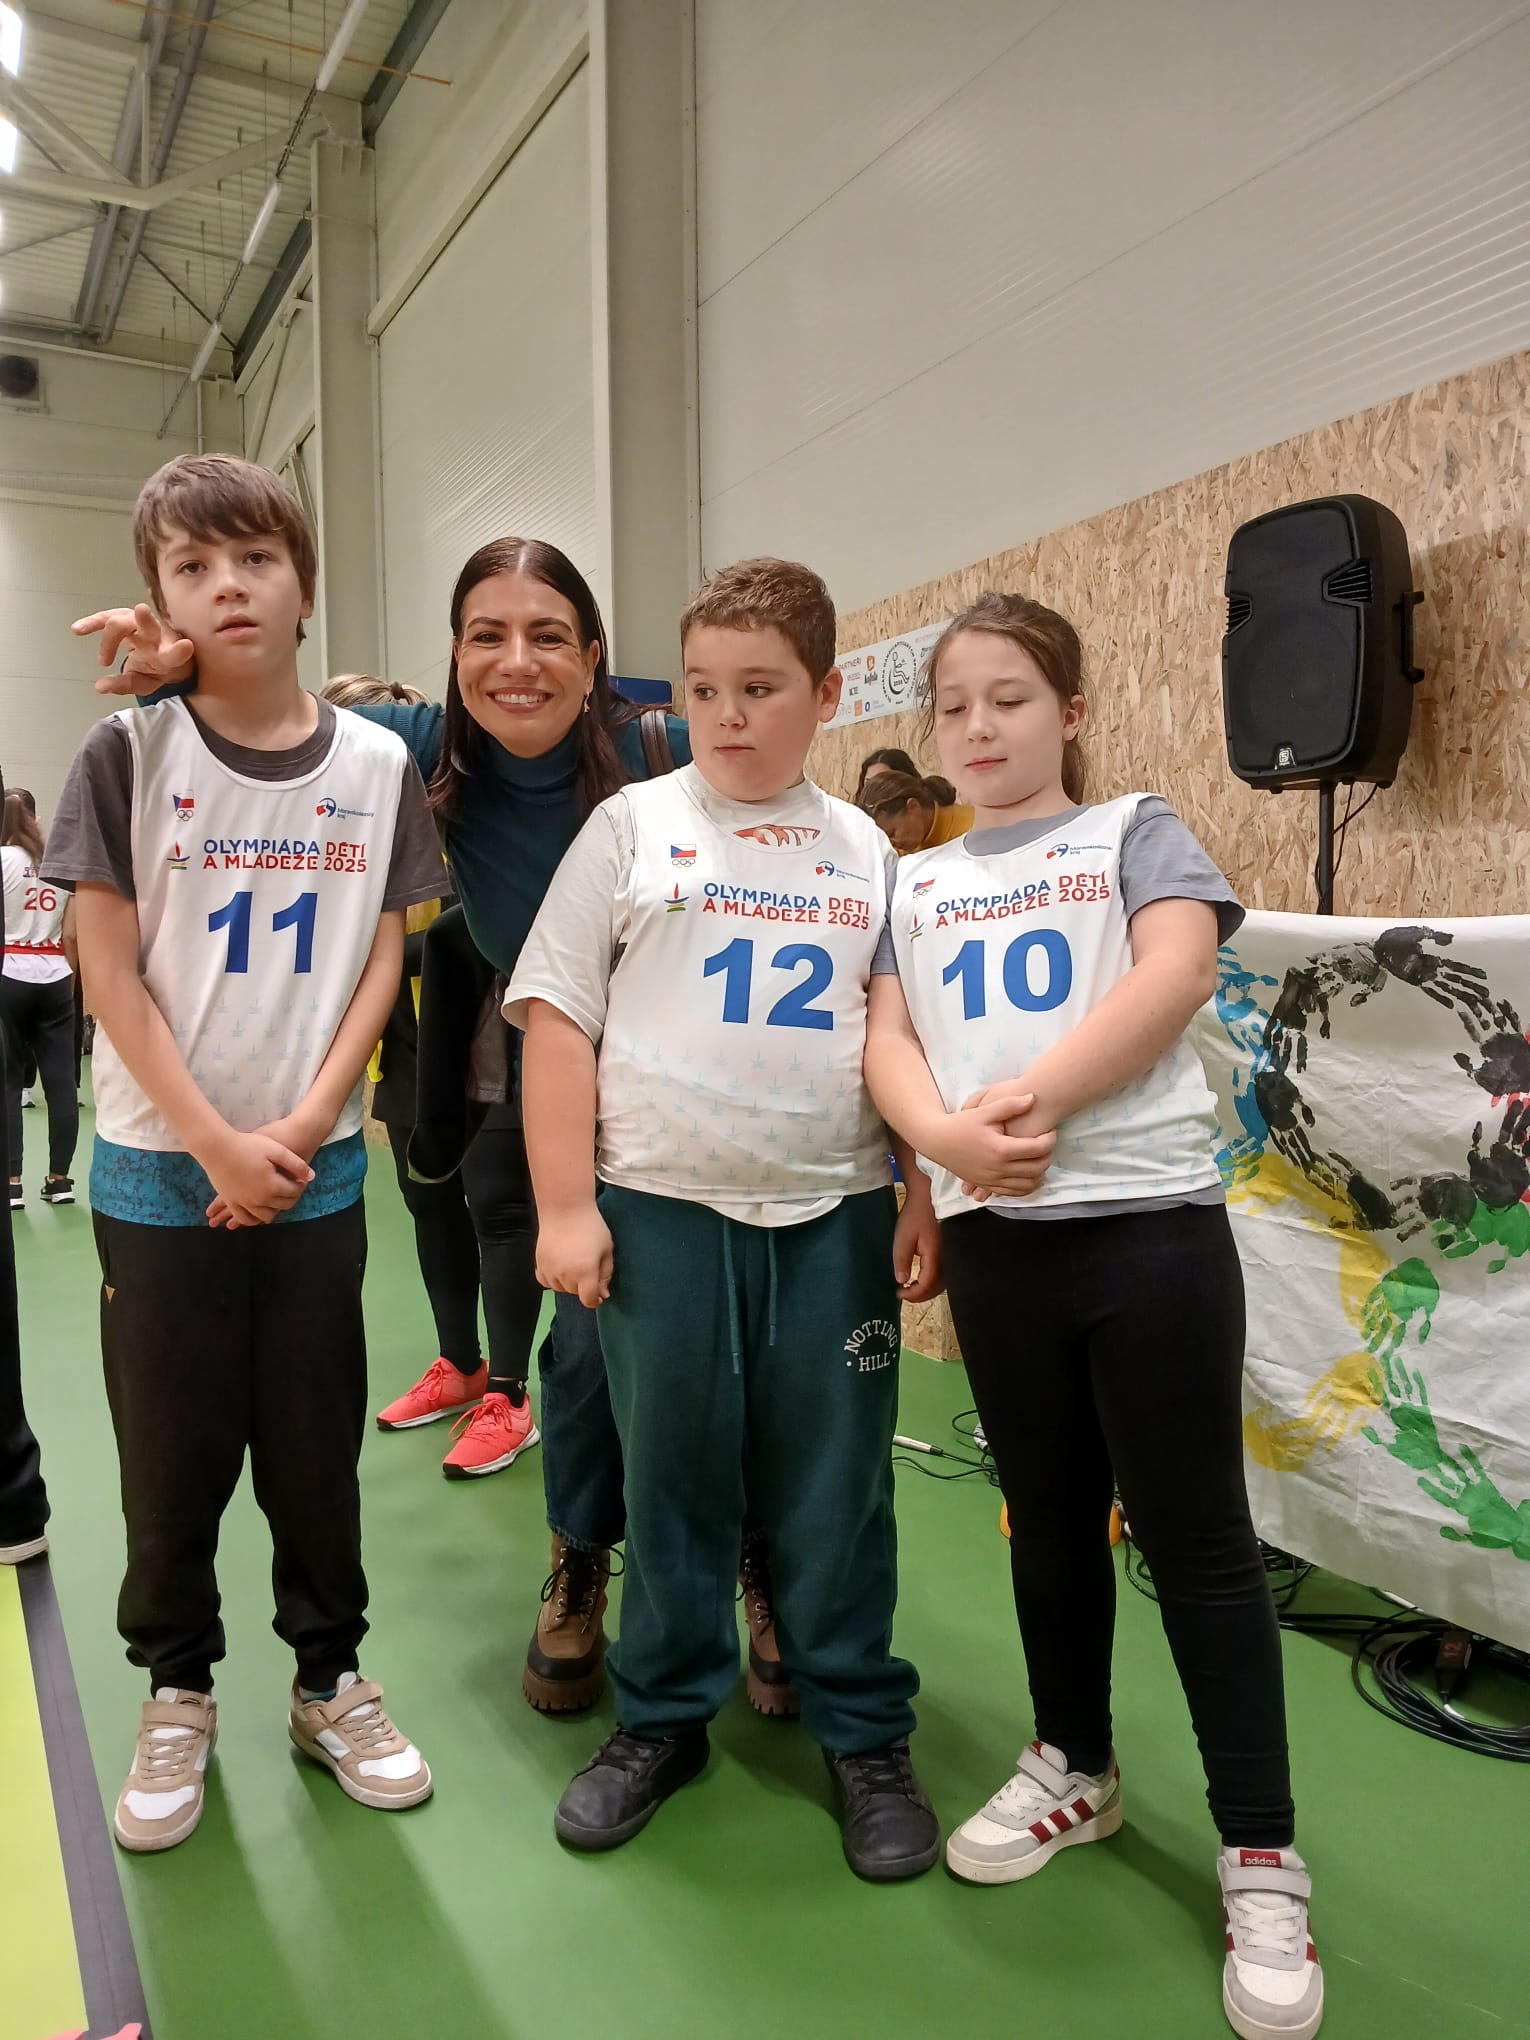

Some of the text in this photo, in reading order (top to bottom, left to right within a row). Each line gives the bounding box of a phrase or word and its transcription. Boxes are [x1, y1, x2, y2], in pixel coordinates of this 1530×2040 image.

[203, 838, 320, 855] OLYMPIÁDA
[203, 854, 218, 869] A
[323, 856, 367, 873] 2025
[23, 887, 57, 912] 26
[703, 882, 821, 910] OLYMPIÁDA
[936, 914, 949, 929] A
[1058, 885, 1111, 903] 2025
[702, 897, 717, 913] A
[827, 910, 870, 931] 2025
[208, 891, 319, 974] 11
[703, 937, 834, 1031] 12
[942, 928, 1073, 1021] 10
[843, 1319, 899, 1355] NOTTING
[858, 1352, 891, 1372] HILL
[1244, 1857, 1278, 1866] adidas
